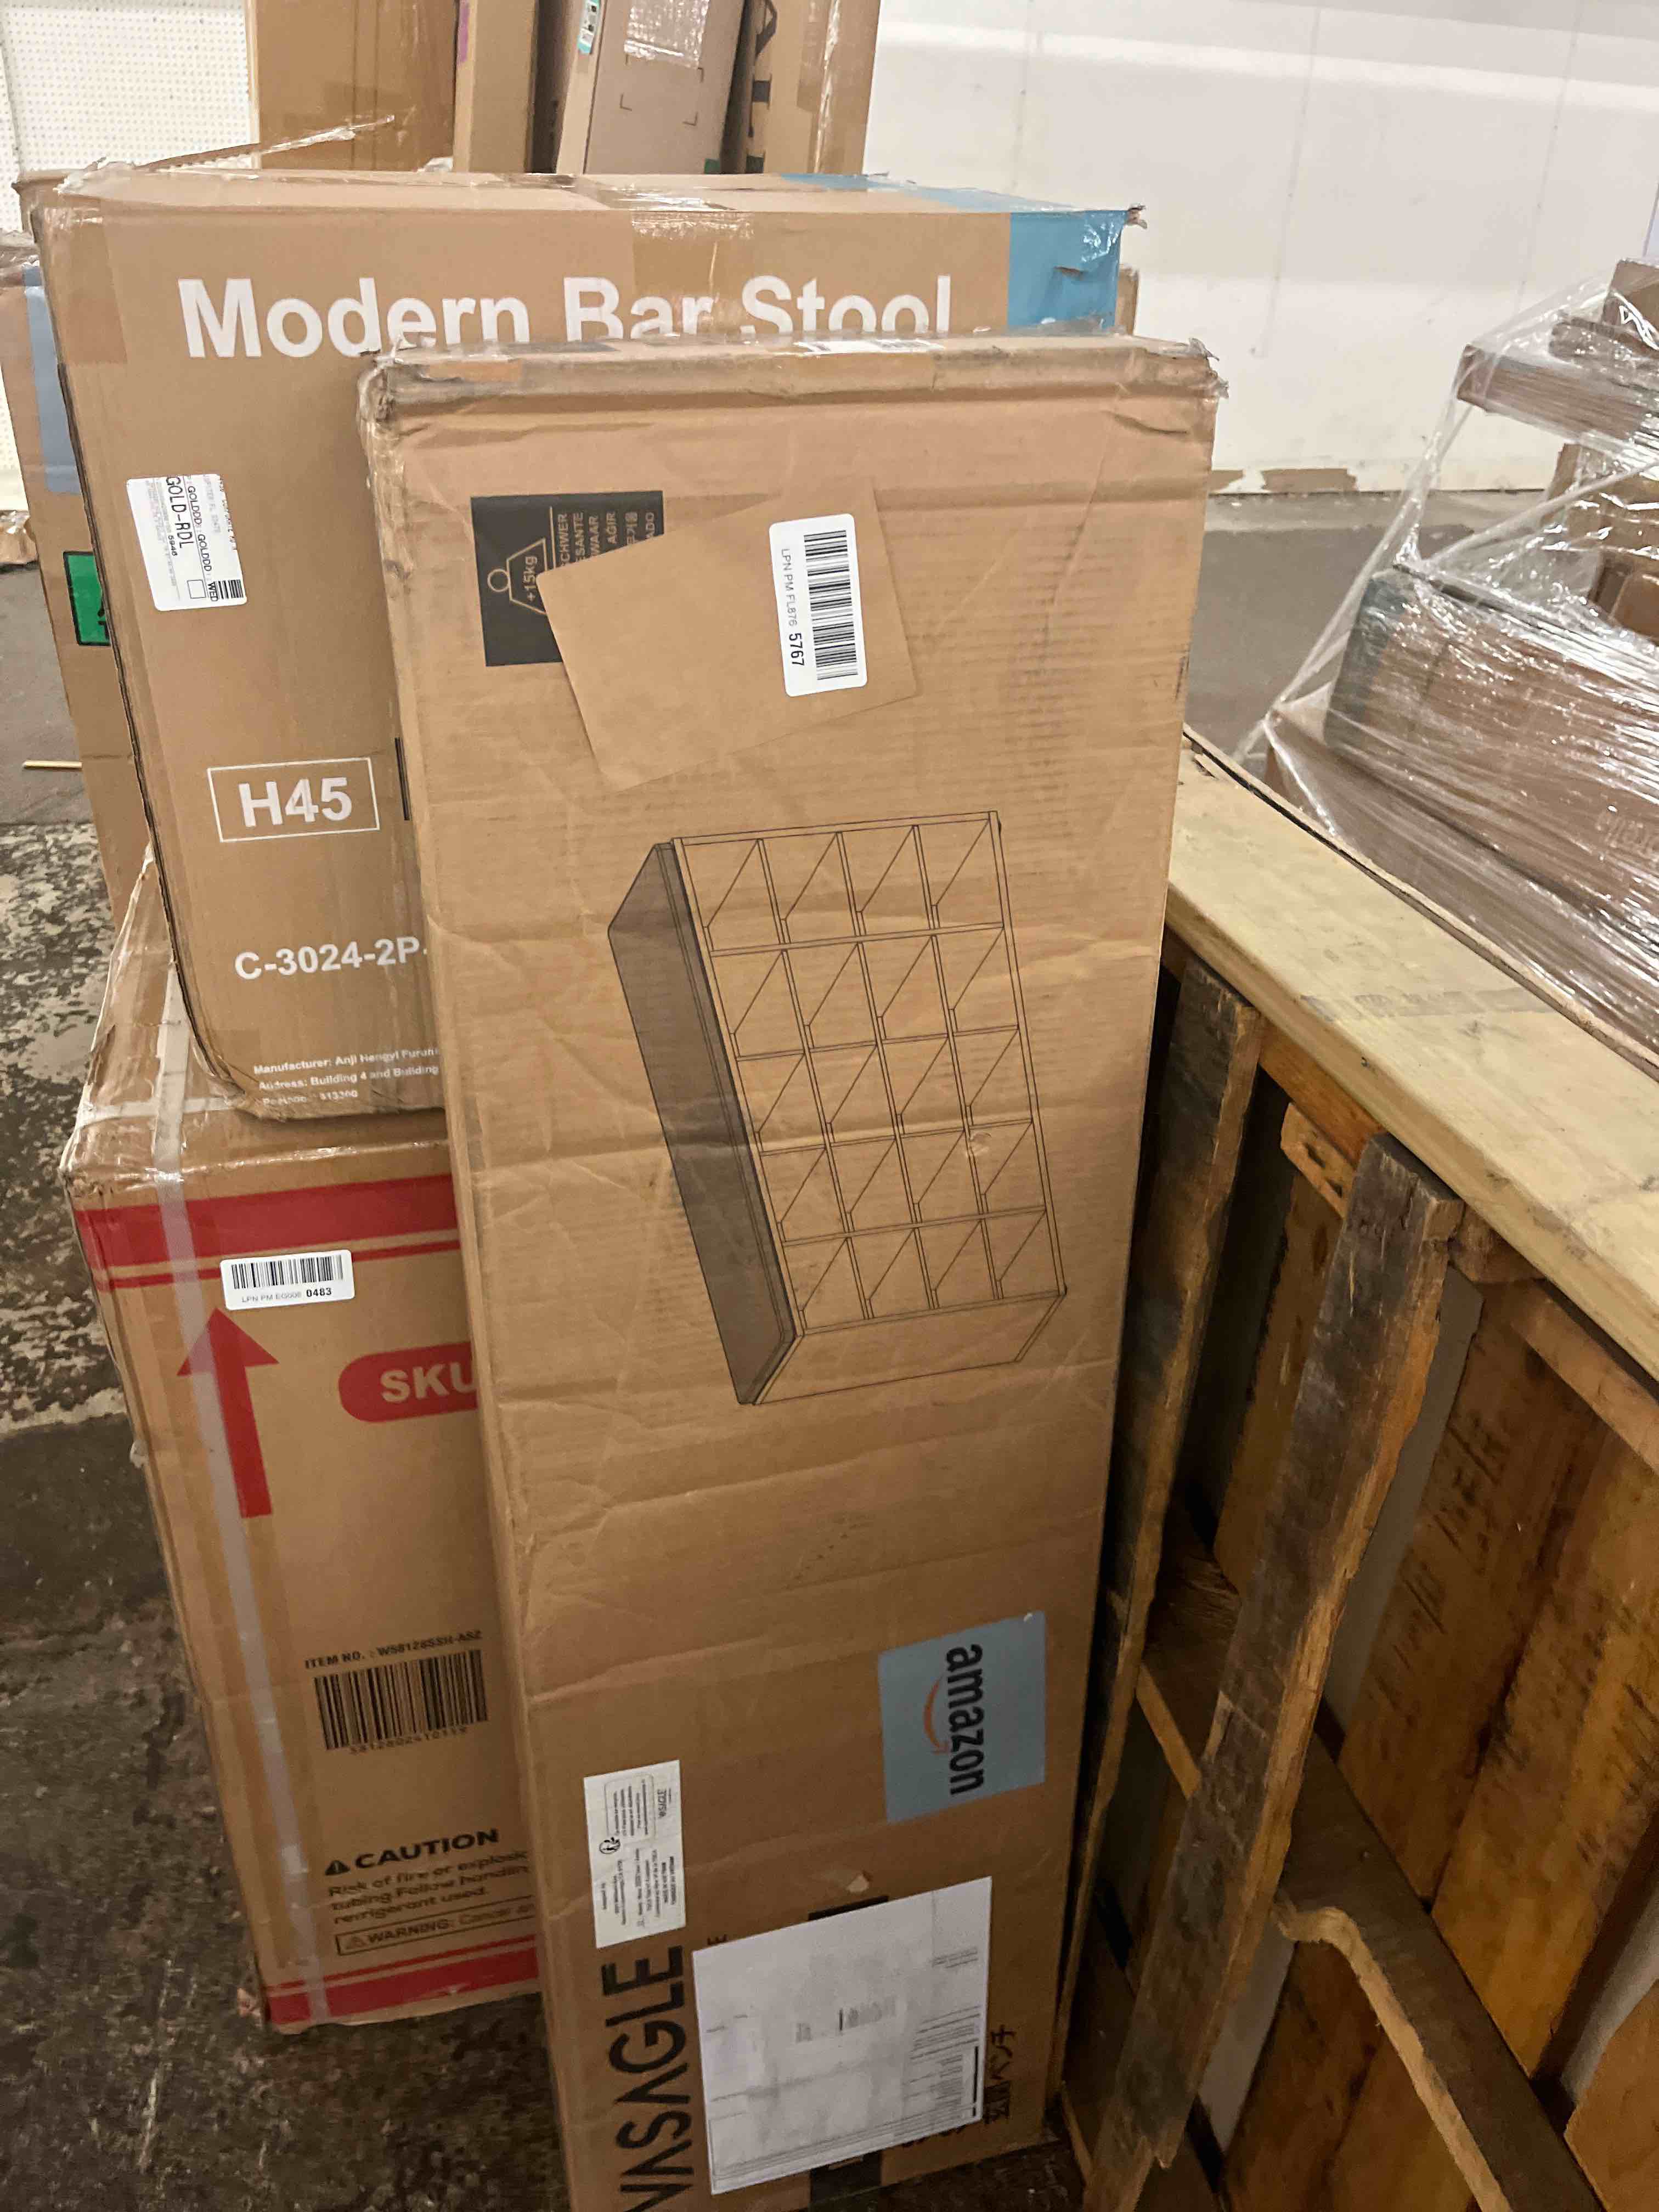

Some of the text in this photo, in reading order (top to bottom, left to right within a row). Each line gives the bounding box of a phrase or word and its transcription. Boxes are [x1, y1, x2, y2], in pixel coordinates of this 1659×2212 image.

[178, 275, 951, 358] Modern Bar Stool
[166, 476, 195, 549] GOLD-RDL
[781, 548, 792, 571] LPN
[523, 555, 538, 602] +15kg
[784, 574, 794, 591] PM
[788, 633, 805, 666] 5767
[238, 777, 352, 827] H45
[235, 936, 427, 980] C-3024-2P
[253, 1058, 332, 1075] Manufacturer:
[310, 1073, 358, 1086] Building
[306, 1287, 332, 1298] 0483
[304, 1654, 339, 1669] ITEM
[946, 1644, 985, 1796] amazon
[354, 1827, 500, 1869] CAUTION
